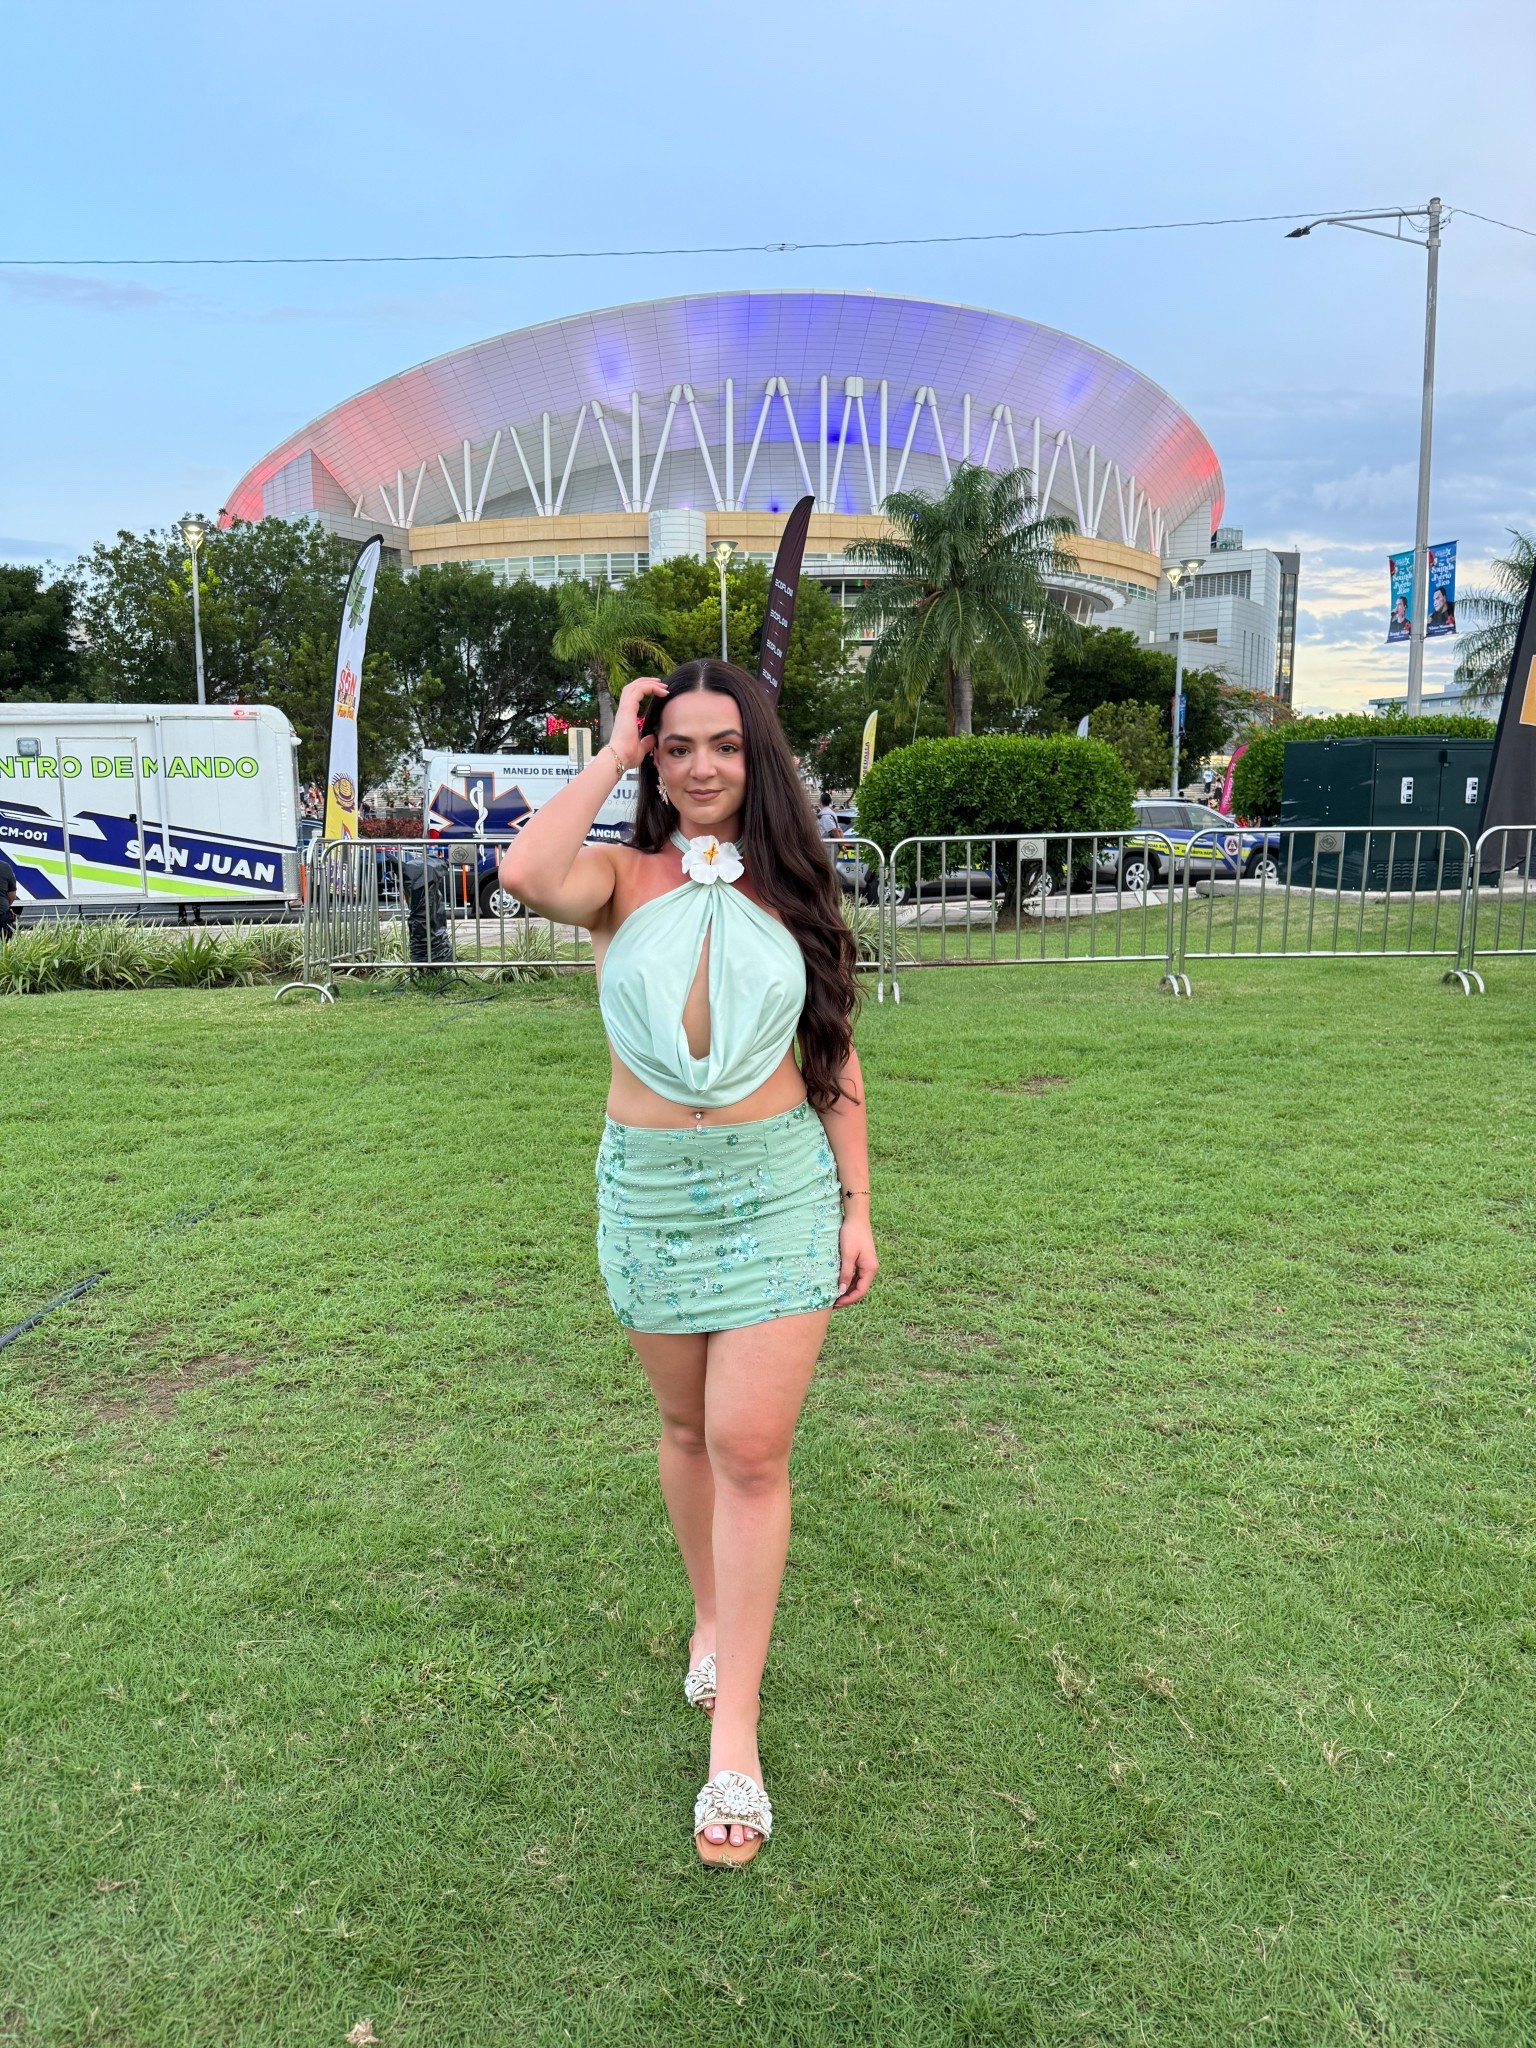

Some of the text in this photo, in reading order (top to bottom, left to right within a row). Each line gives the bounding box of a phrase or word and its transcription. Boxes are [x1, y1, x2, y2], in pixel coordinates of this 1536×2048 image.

[1431, 564, 1454, 573] Sounds
[1431, 572, 1451, 581] Puerto
[339, 669, 357, 696] SON
[0, 755, 259, 779] NTRO DE MANDO
[503, 767, 539, 776] MANEJO
[541, 767, 554, 776] DE
[0, 825, 48, 842] CM-001
[124, 839, 276, 883] SAN JUAN
[846, 866, 863, 874] 9--1
